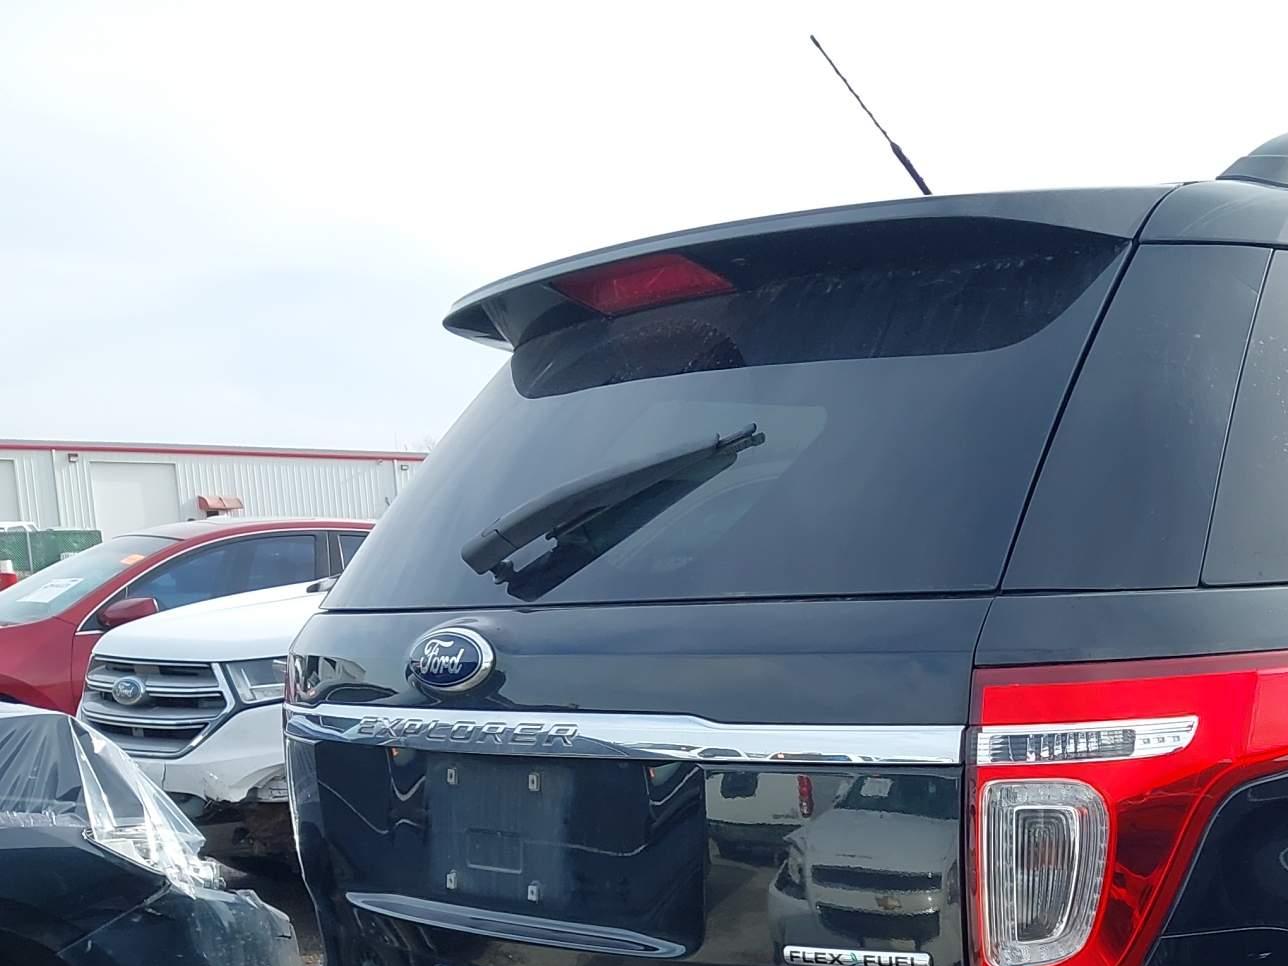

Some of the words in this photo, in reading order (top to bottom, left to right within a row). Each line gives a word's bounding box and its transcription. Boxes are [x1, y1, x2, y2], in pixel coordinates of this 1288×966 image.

[419, 638, 465, 675] Ford
[356, 715, 582, 748] EXPLORER
[789, 950, 846, 966] FLEX
